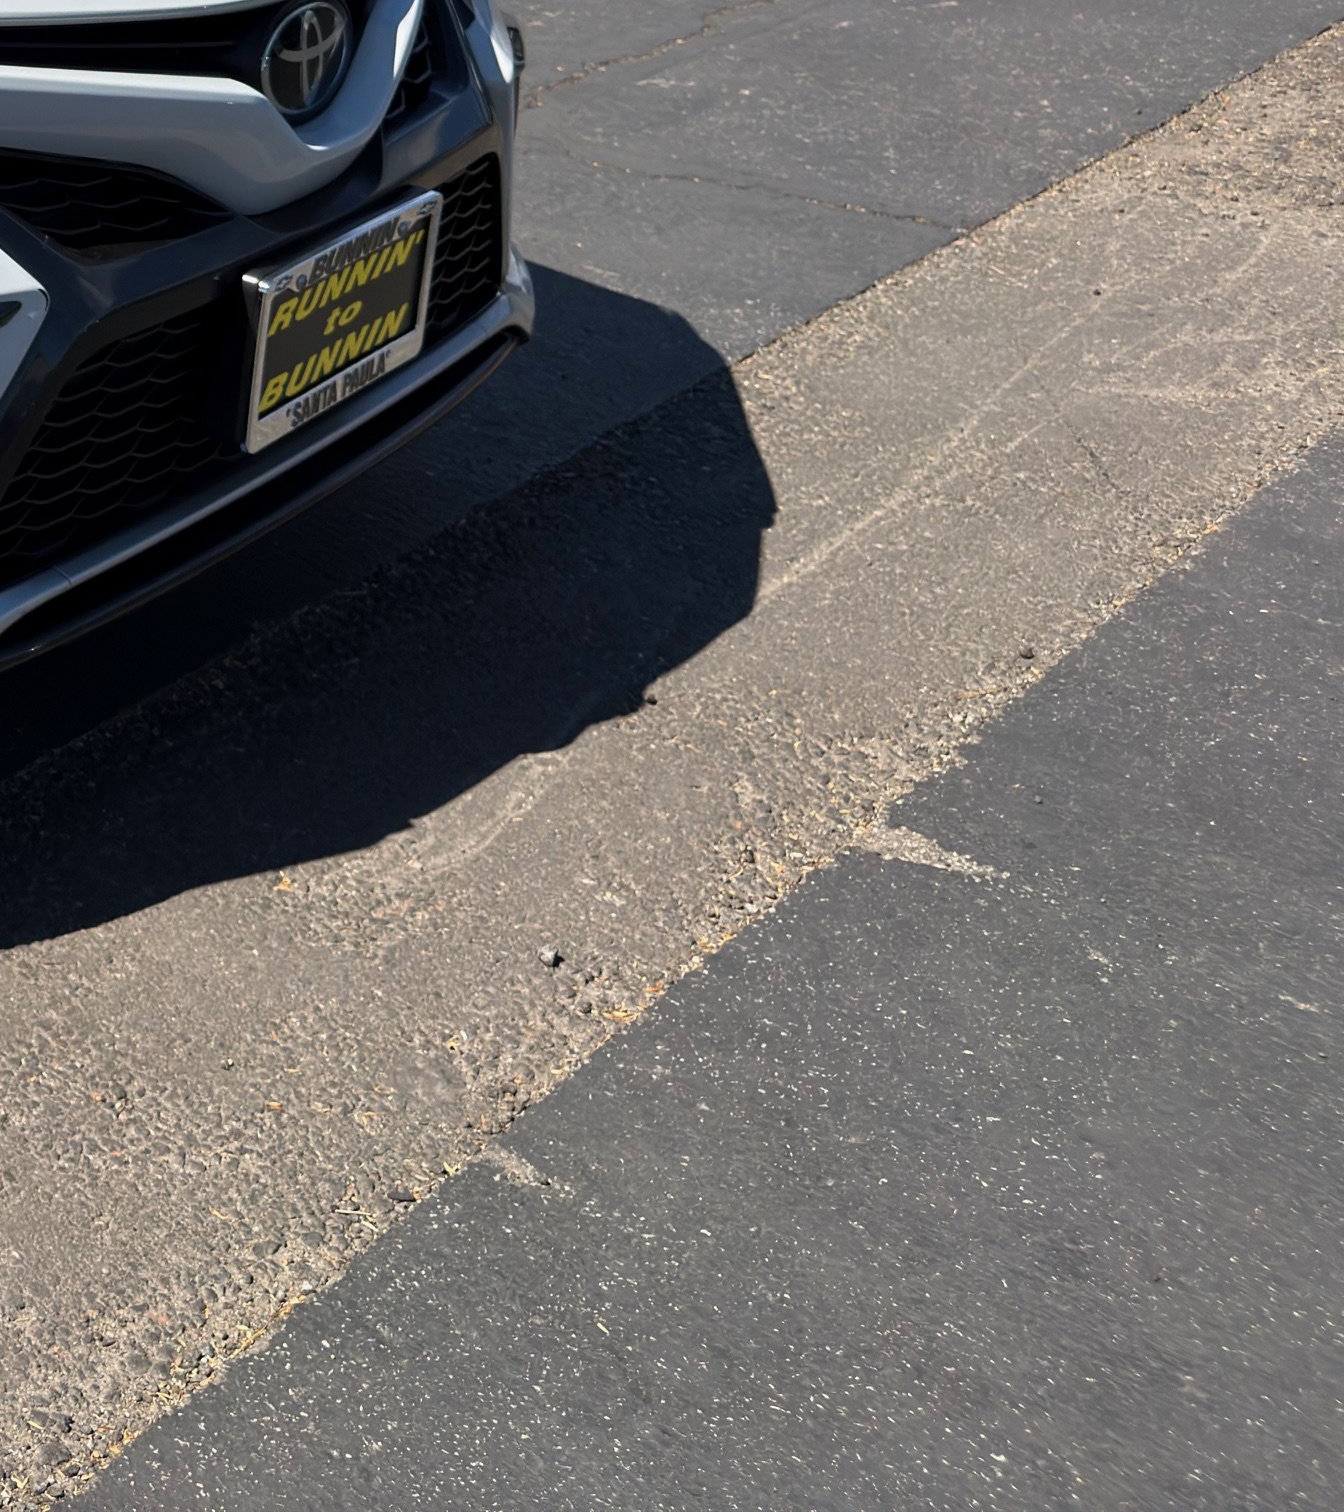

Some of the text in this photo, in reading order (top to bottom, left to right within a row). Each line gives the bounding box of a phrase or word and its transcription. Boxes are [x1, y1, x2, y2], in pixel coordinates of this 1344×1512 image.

[313, 218, 400, 281] BUNNIN
[323, 300, 363, 337] to
[258, 301, 410, 416] BUNNIN
[290, 351, 386, 428] SANTA PAULA
